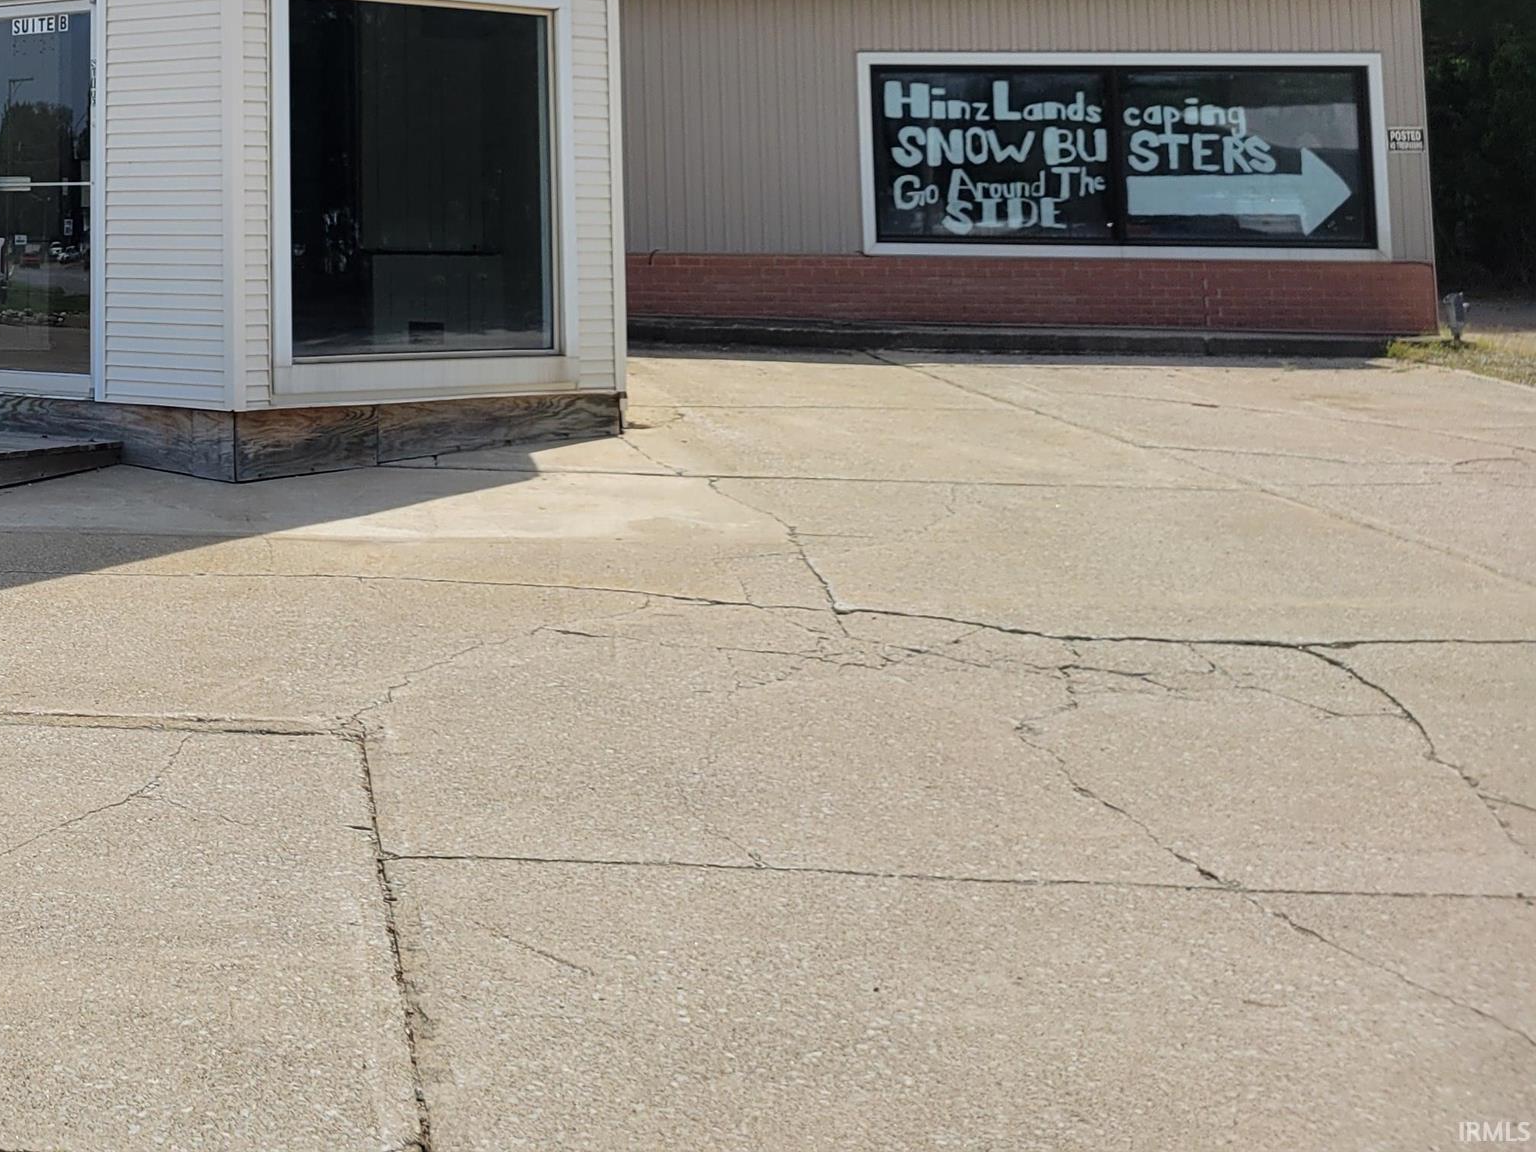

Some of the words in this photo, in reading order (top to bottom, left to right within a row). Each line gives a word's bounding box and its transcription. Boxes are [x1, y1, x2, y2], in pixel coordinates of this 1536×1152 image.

[14, 17, 54, 34] SUITE
[60, 16, 68, 30] B
[884, 80, 991, 121] Hinz
[1390, 130, 1421, 142] POSTED
[893, 174, 939, 210] Go
[947, 168, 1045, 202] Around
[1051, 166, 1106, 203] The
[942, 197, 1068, 236] SIDE
